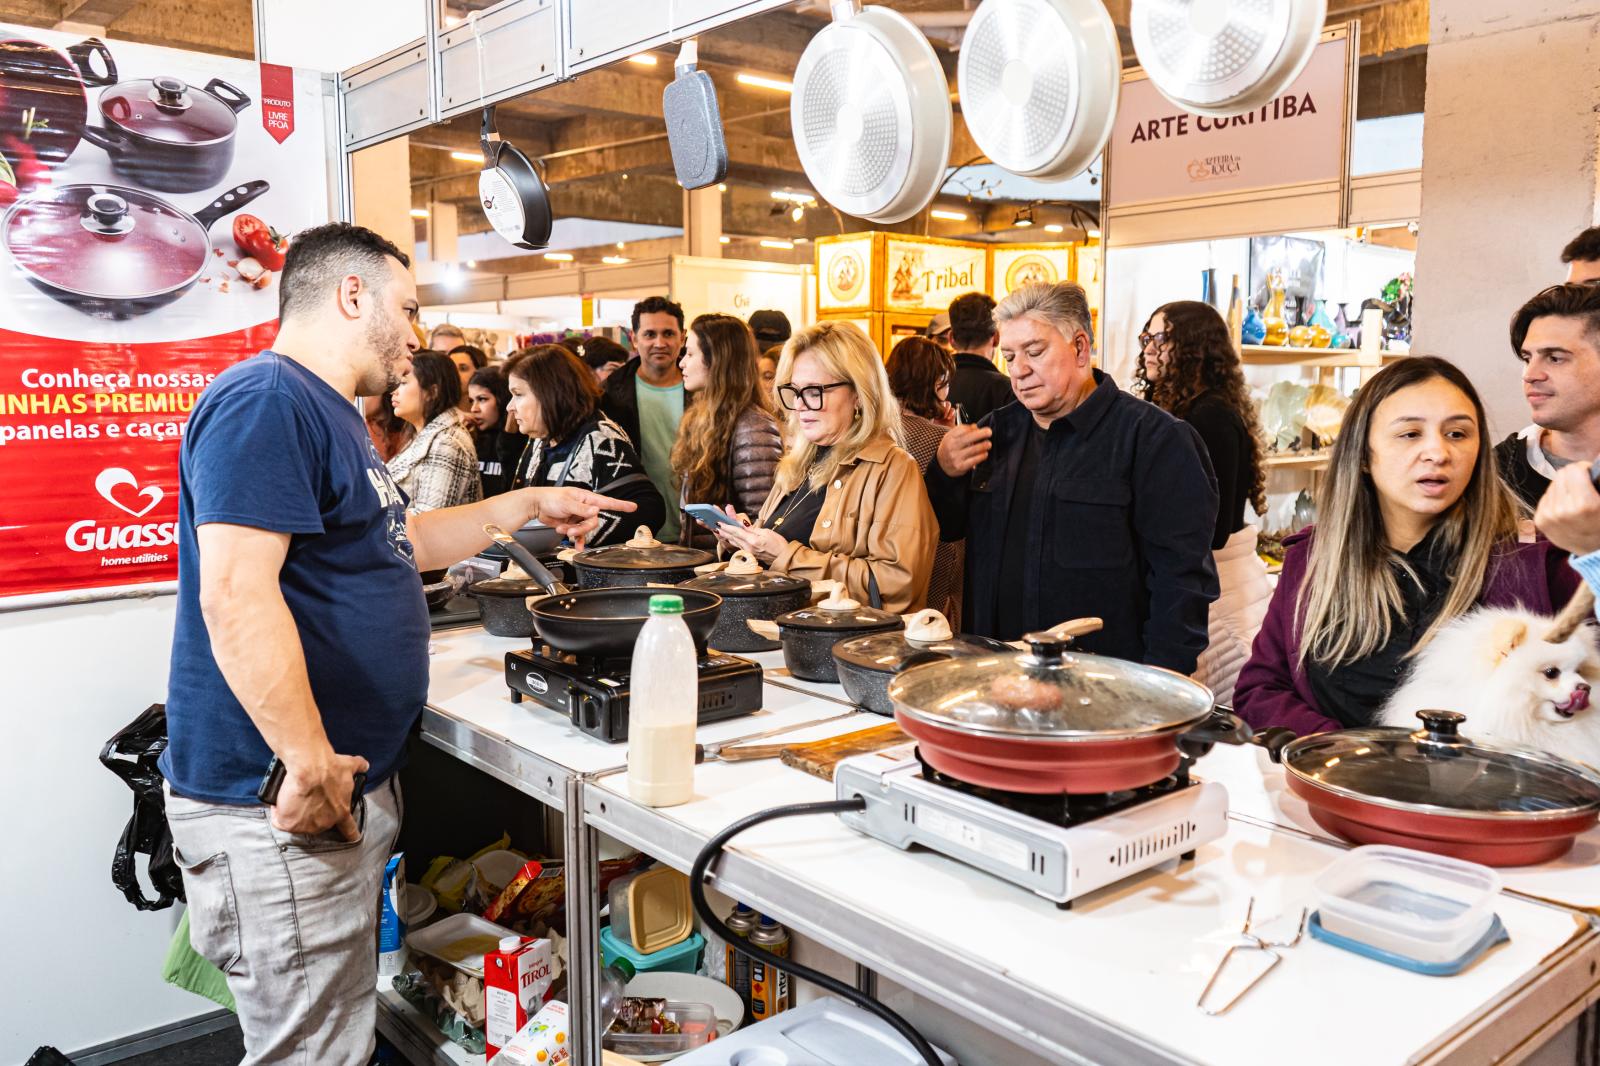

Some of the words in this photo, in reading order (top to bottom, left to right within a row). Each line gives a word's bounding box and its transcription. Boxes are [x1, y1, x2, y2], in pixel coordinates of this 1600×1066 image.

[263, 98, 291, 108] PRODUTO
[268, 111, 289, 122] LIVRE
[268, 119, 289, 130] PFOA
[1131, 114, 1189, 143] ARTE
[921, 263, 975, 292] Tribal
[21, 368, 131, 393] Conheça
[0, 419, 100, 446] panelas
[106, 424, 120, 438] e
[65, 519, 179, 552] Guass
[101, 556, 131, 566] home
[132, 553, 168, 563] utilities
[520, 964, 552, 989] TIROL
